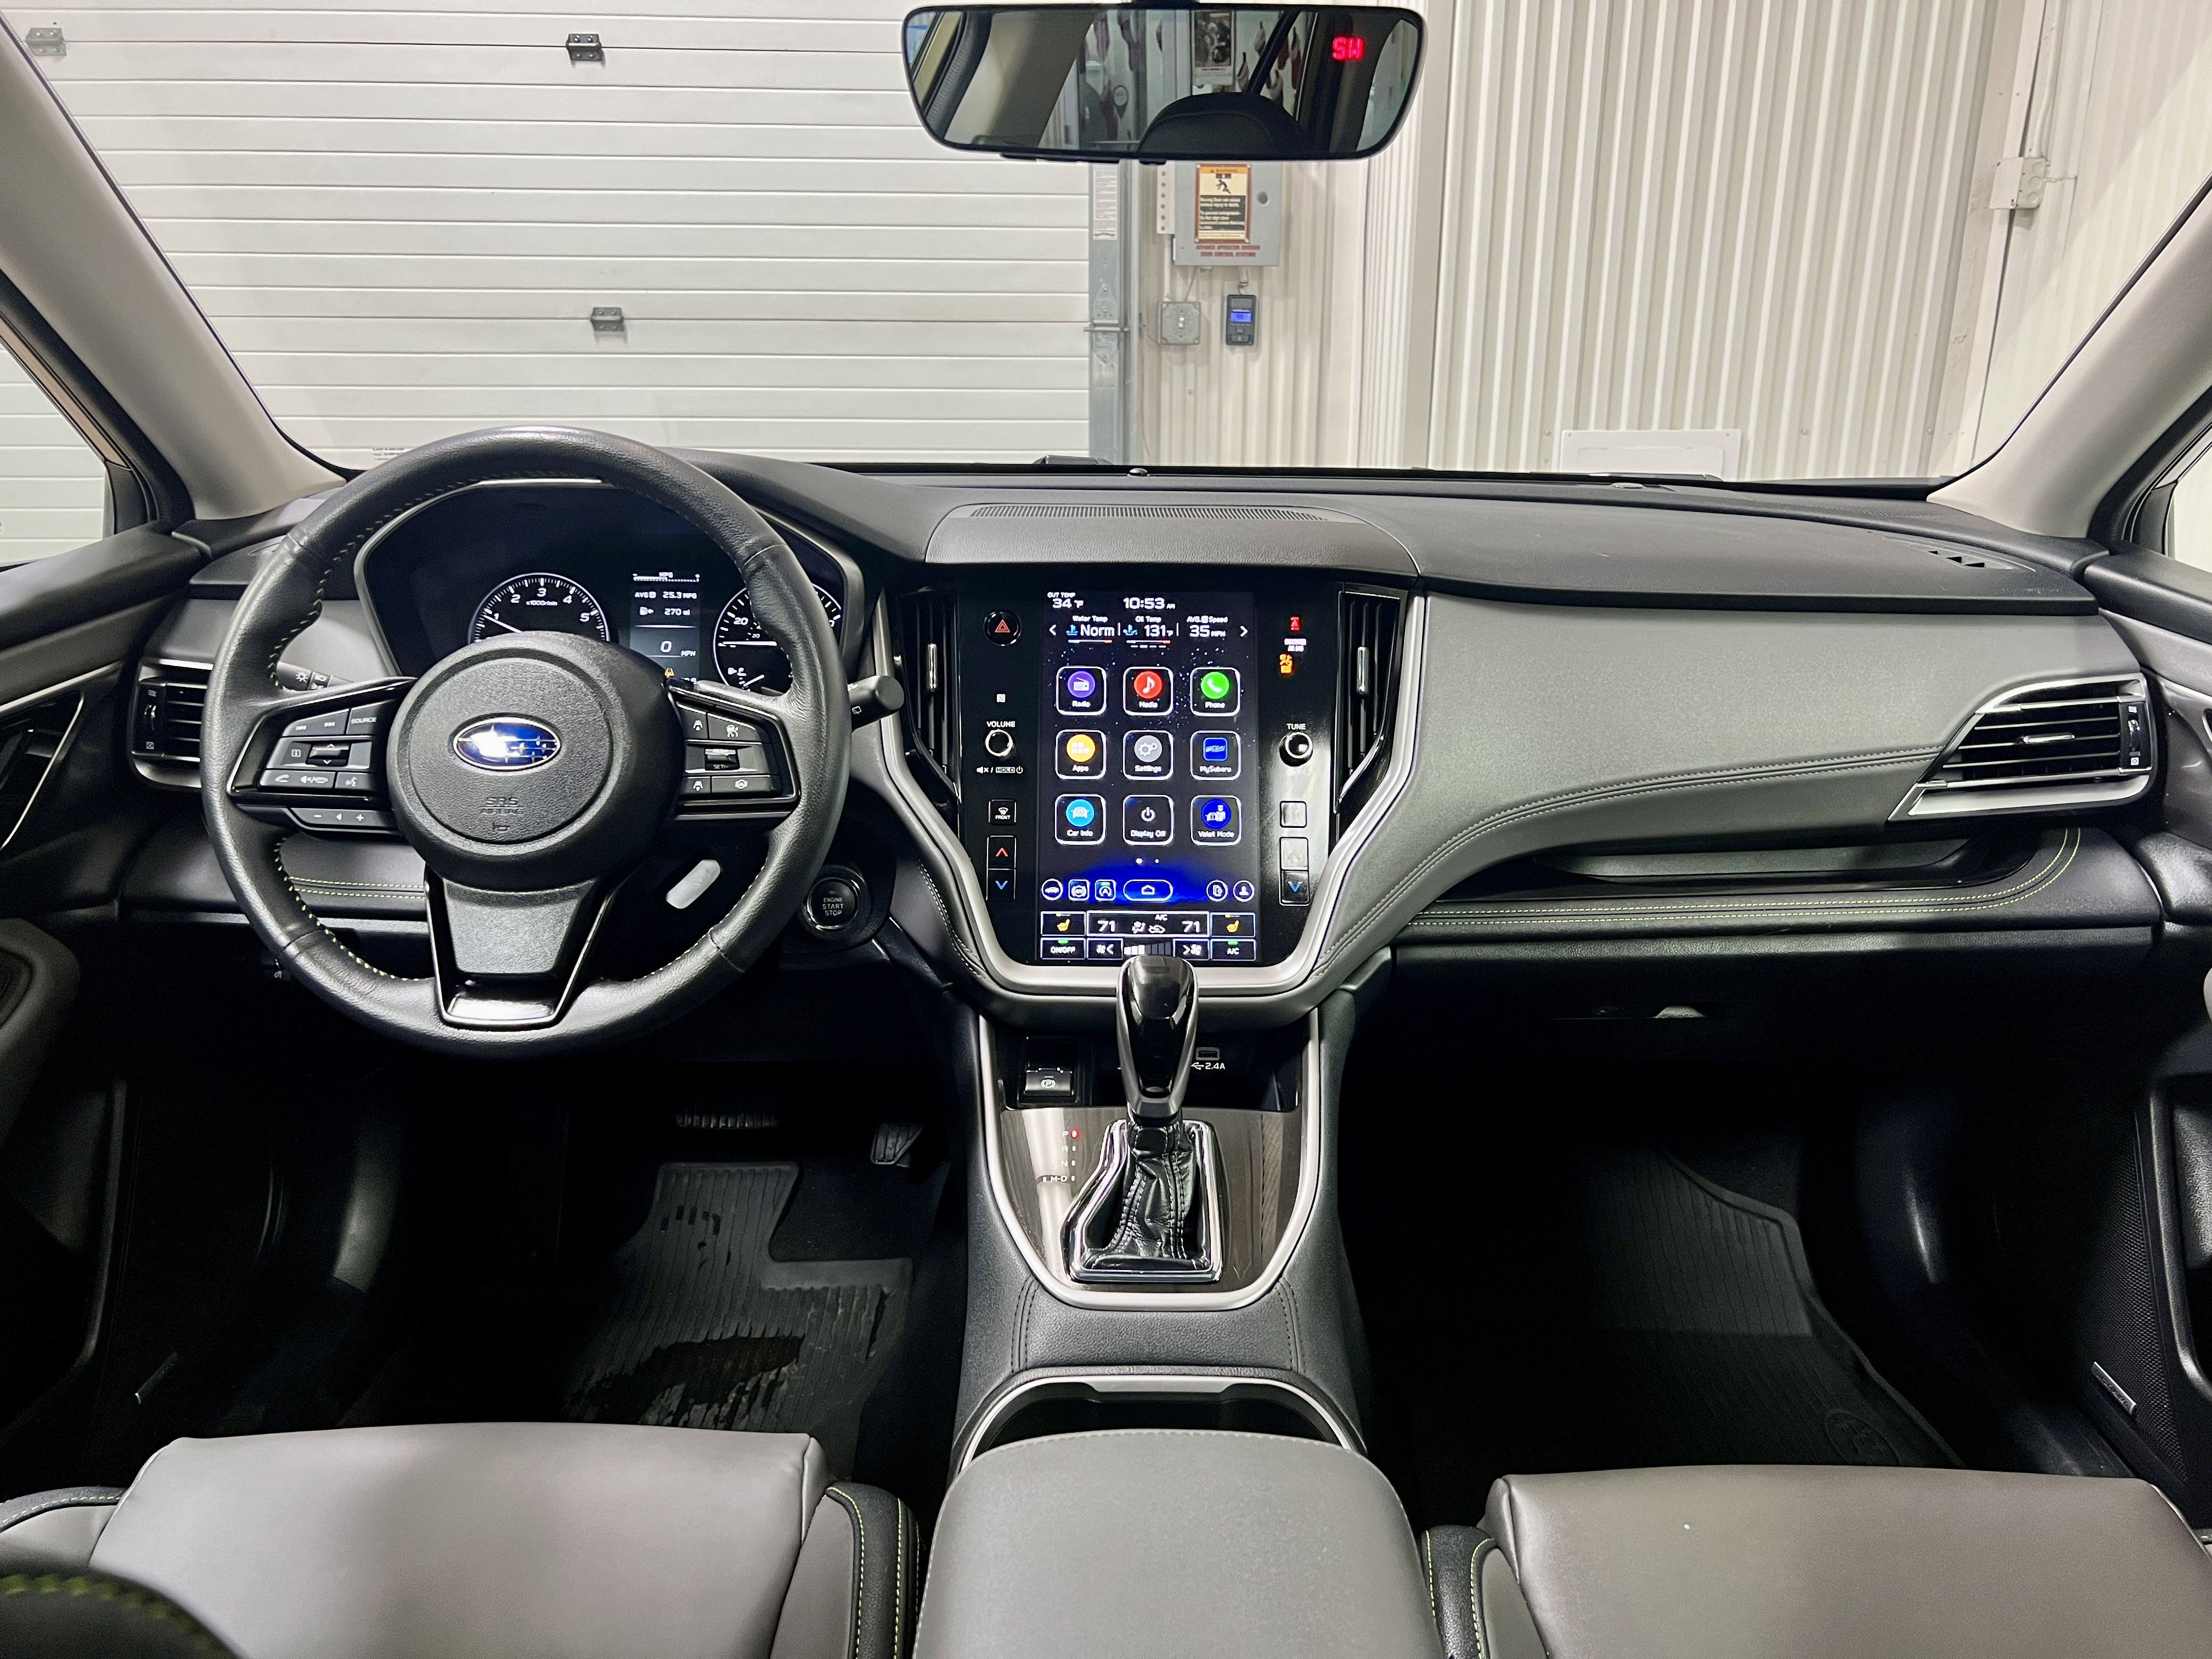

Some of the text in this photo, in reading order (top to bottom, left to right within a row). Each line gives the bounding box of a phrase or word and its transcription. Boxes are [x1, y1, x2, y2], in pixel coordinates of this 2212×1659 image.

[1332, 36, 1364, 60] SW
[511, 594, 521, 603] 2
[537, 588, 546, 597] 3
[563, 595, 572, 604] 4
[1052, 598, 1072, 608] 34
[1123, 597, 1165, 610] 10:53
[579, 613, 590, 622] 5
[1080, 624, 1115, 636] Norm
[1144, 624, 1166, 637] 131
[1189, 624, 1210, 637] 35
[660, 640, 672, 653] 0
[1097, 921, 1115, 932] 71
[1182, 921, 1200, 933] 71
